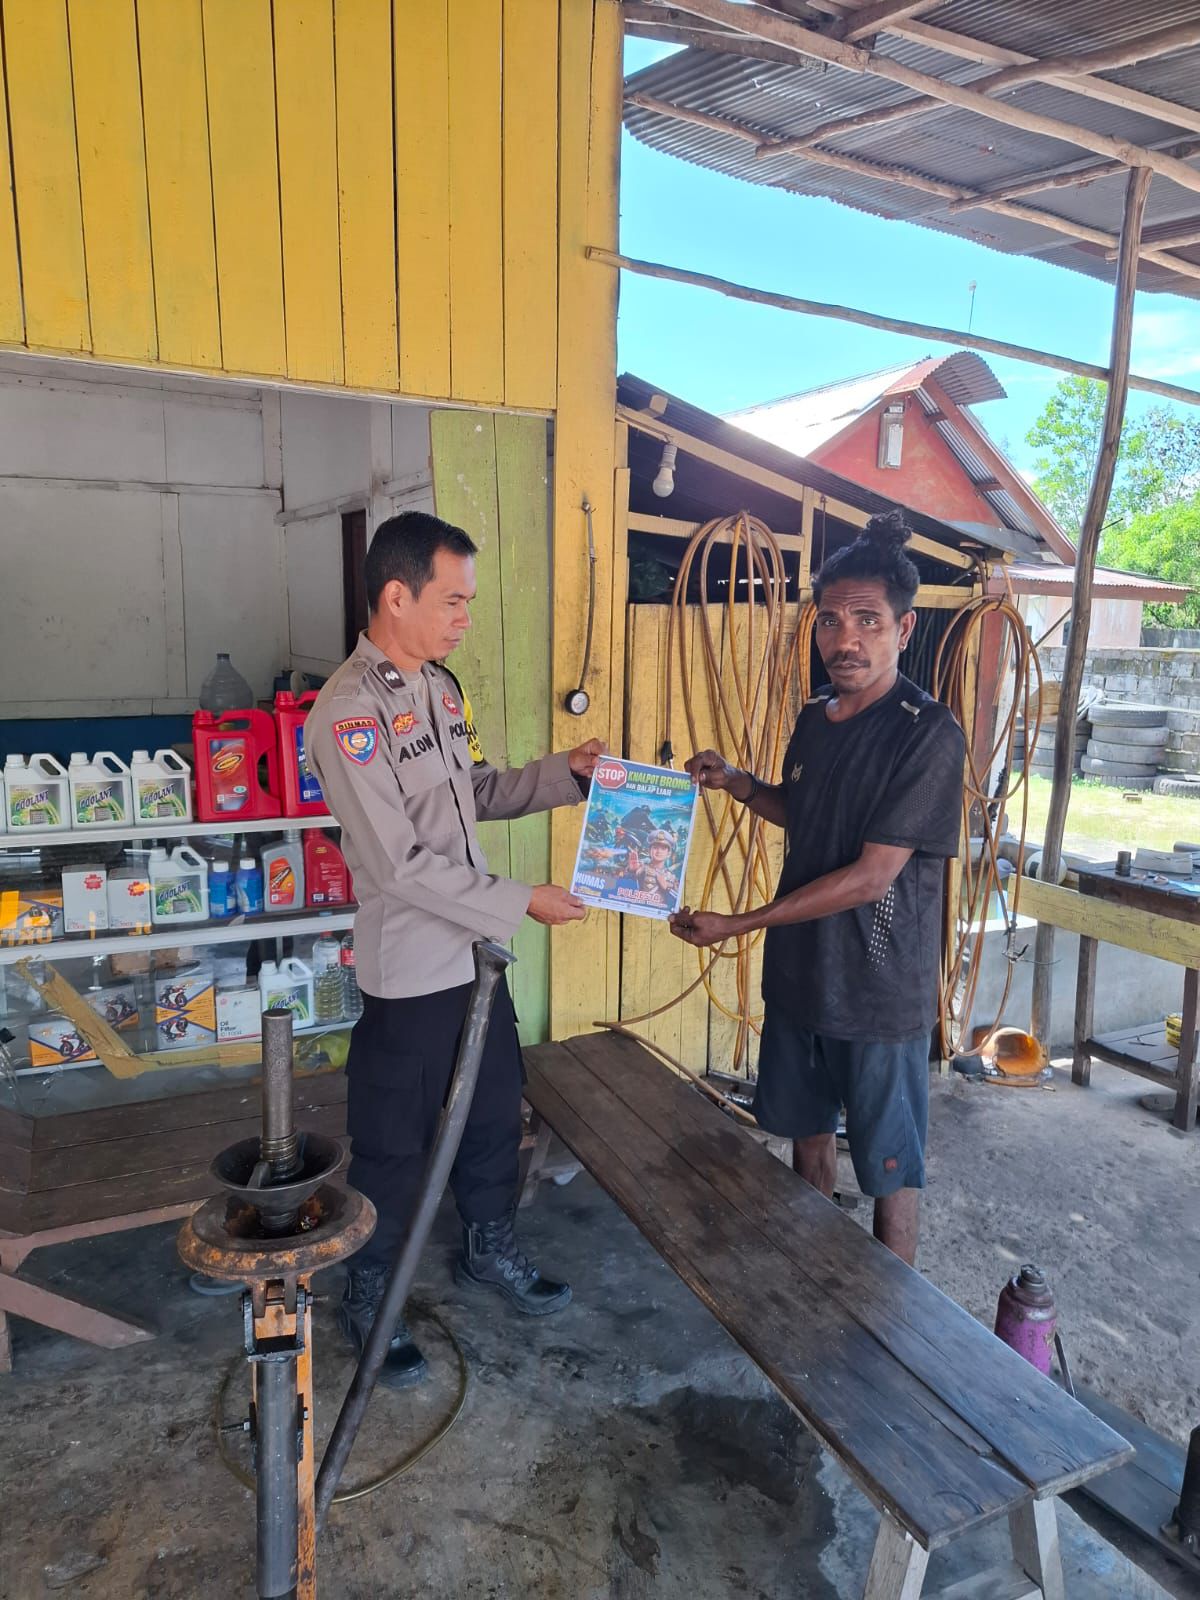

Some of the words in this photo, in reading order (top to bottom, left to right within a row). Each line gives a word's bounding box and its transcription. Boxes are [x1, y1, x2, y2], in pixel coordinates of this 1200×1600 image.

[399, 733, 434, 763] ALON
[598, 768, 625, 781] STOP
[628, 770, 660, 785] KNALPOT
[660, 775, 691, 790] BRONG
[15, 789, 49, 811] COOLANT
[79, 787, 113, 808] COOLANT
[143, 784, 175, 804] COOLANT
[637, 784, 656, 793] BALAP
[656, 787, 672, 797] LIAR
[159, 880, 191, 901] COOLANT
